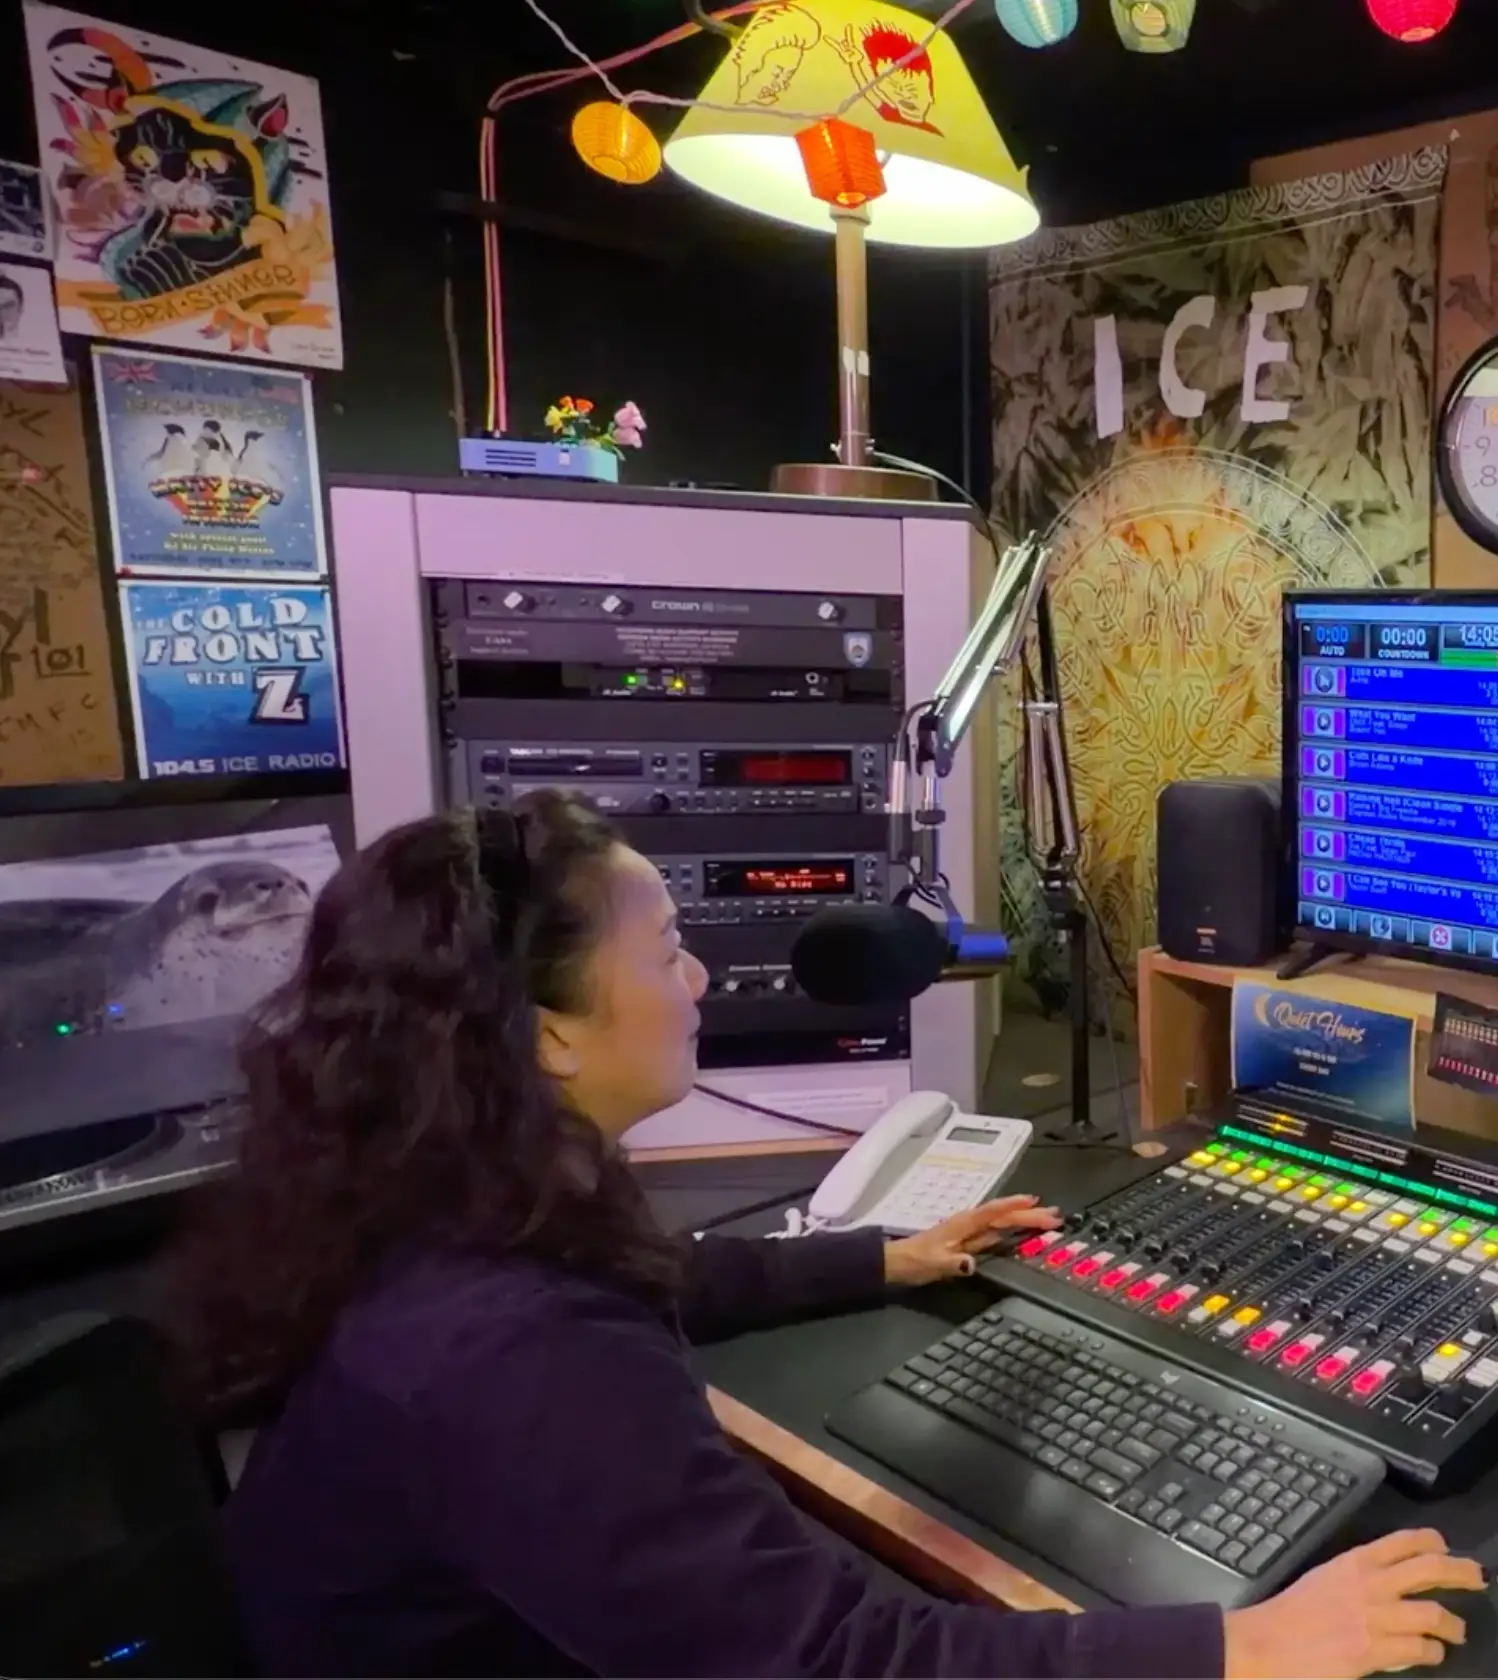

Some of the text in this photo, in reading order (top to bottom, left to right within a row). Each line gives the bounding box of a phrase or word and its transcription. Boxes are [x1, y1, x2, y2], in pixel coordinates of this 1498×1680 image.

[1094, 285, 1309, 439] ICE
[1475, 436, 1491, 456] 9
[1479, 465, 1498, 488] 8
[171, 597, 308, 633] COLD
[1316, 626, 1348, 643] 0:00
[1381, 627, 1426, 646] 00:00
[144, 627, 324, 665] FRONT
[1320, 646, 1344, 657] AUTO
[1377, 648, 1429, 660] COUNTDOWN
[186, 667, 310, 724] WITH Z
[221, 755, 260, 773] ICE
[269, 752, 336, 770] RADIO
[1273, 1001, 1367, 1045] Quiet Hours
